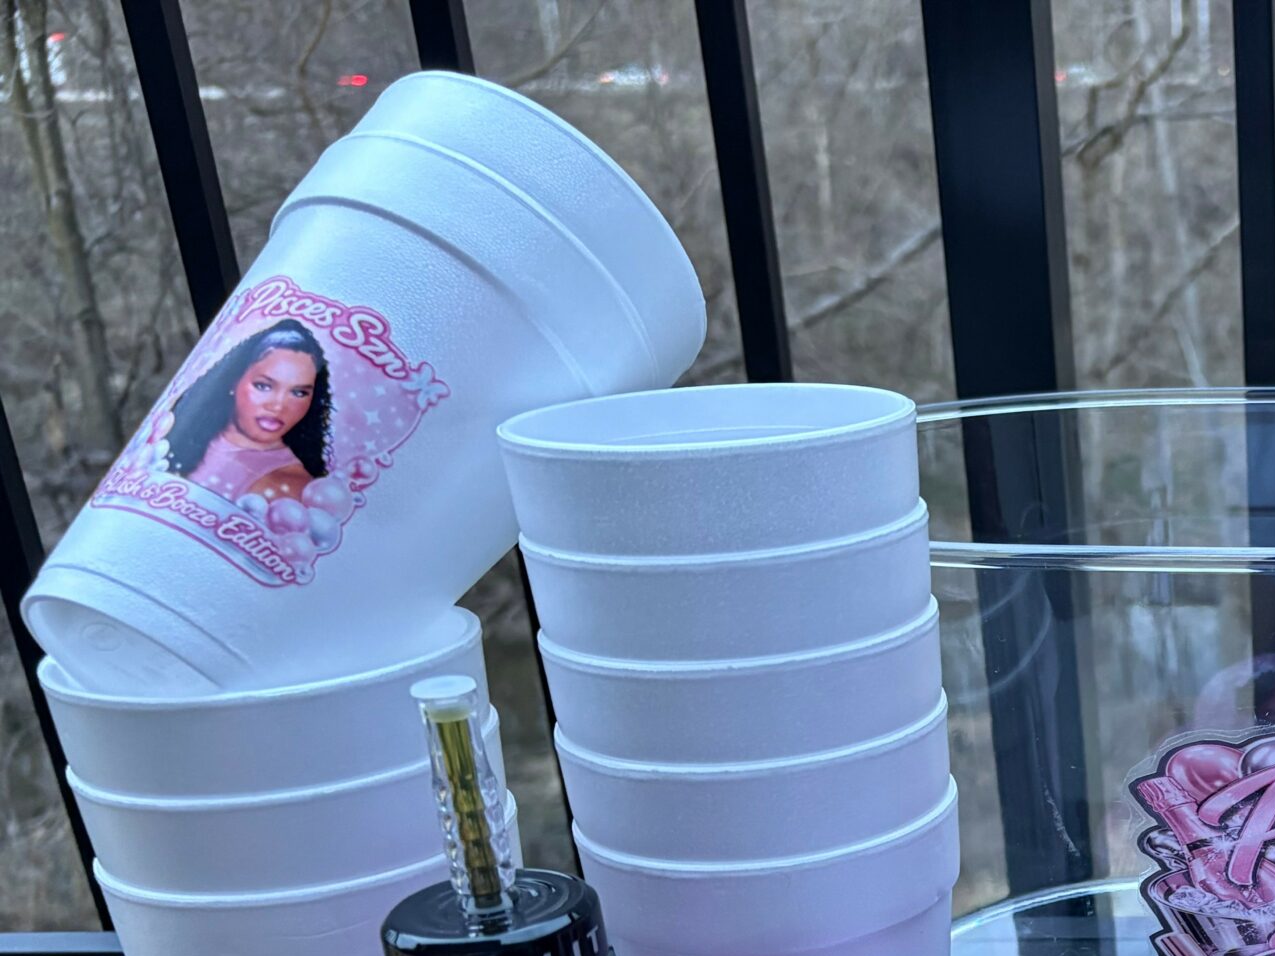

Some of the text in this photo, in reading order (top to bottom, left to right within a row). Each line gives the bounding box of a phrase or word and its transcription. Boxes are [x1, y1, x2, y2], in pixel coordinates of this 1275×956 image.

[238, 279, 409, 379] Pisces Szn
[149, 482, 216, 528] Booze
[216, 515, 296, 582] Edition
